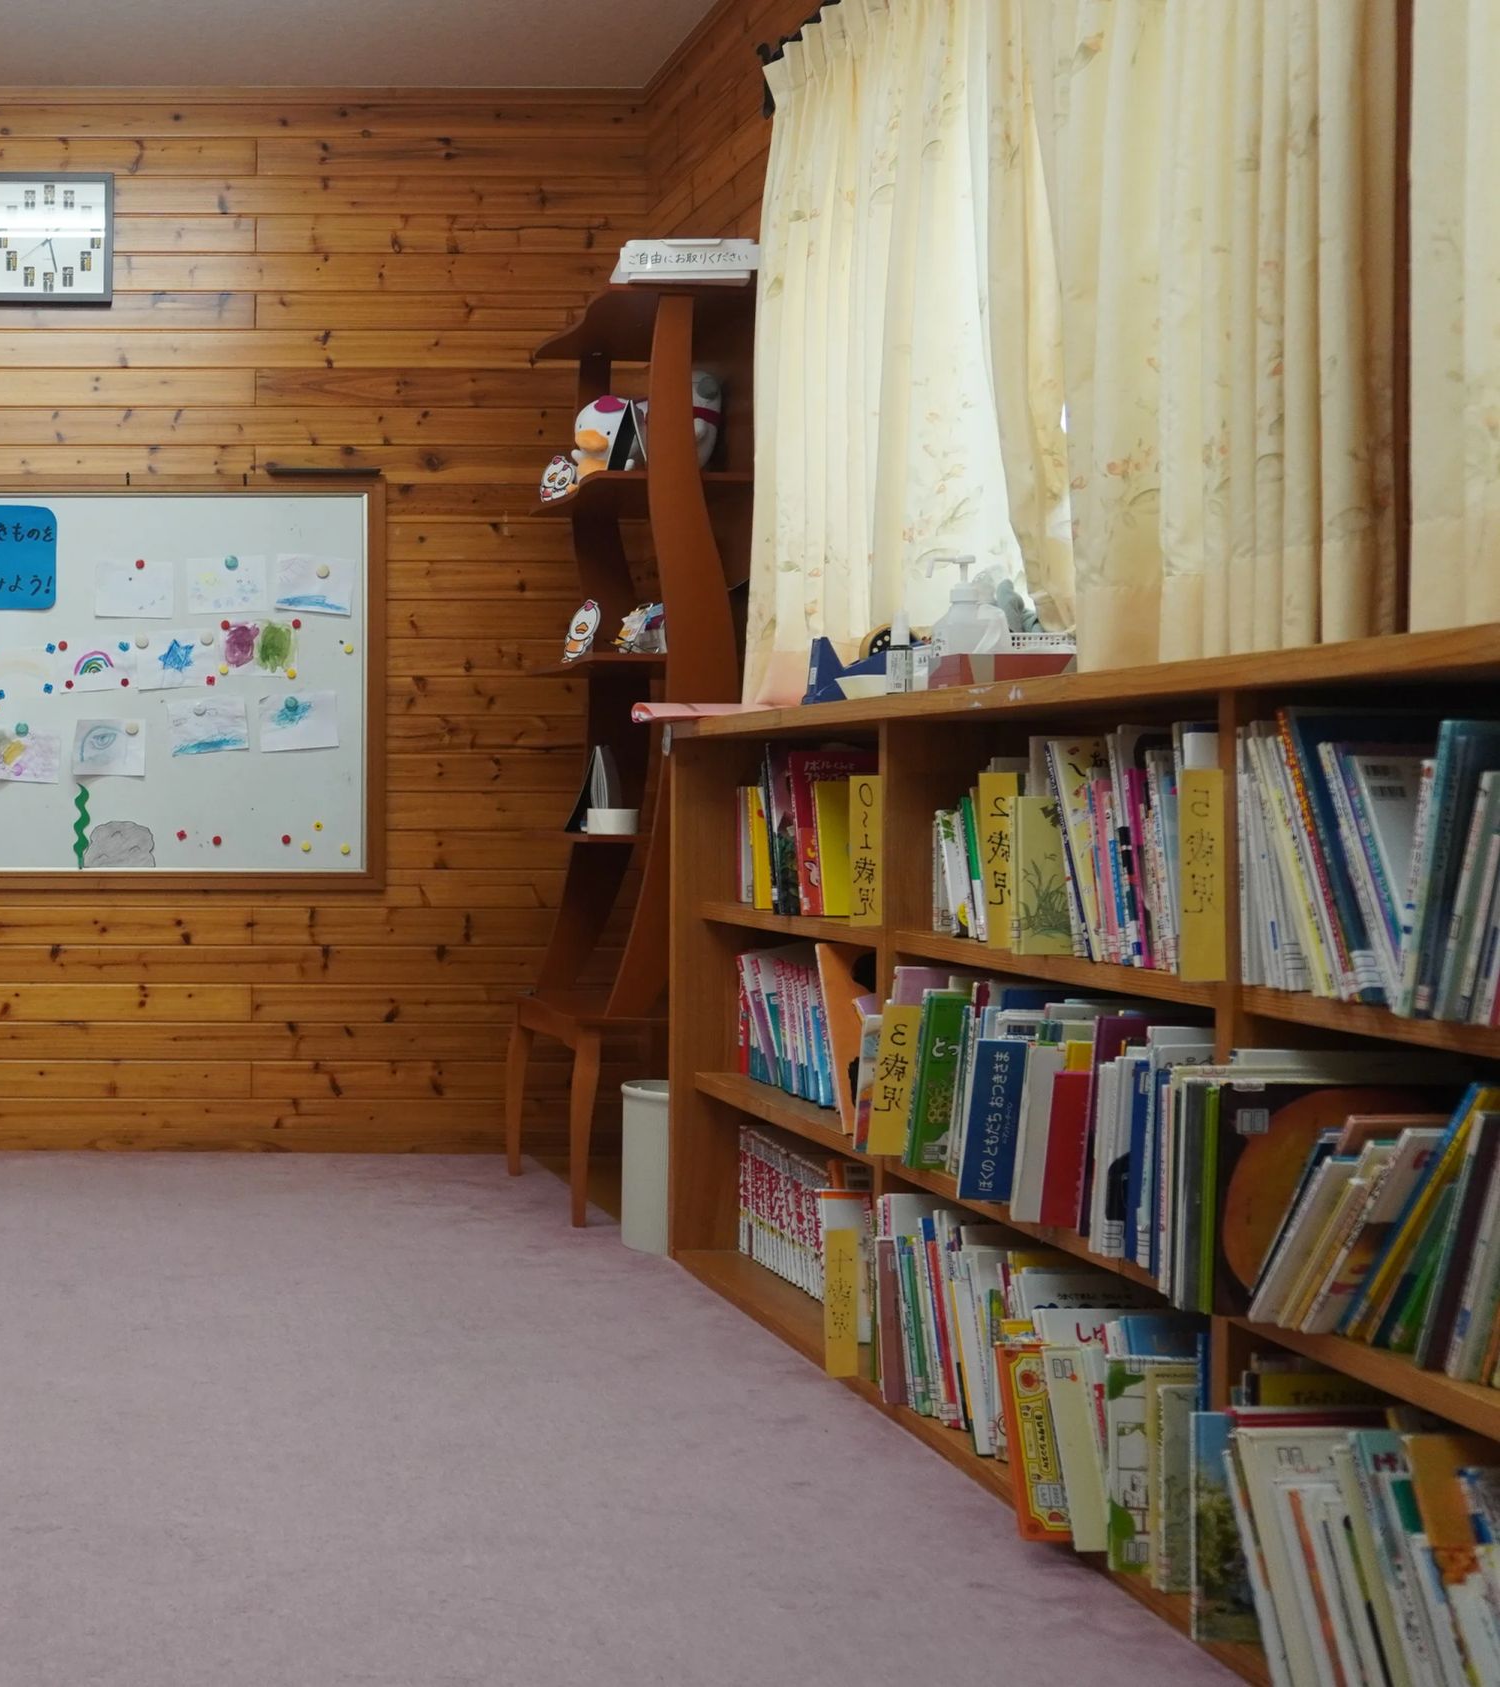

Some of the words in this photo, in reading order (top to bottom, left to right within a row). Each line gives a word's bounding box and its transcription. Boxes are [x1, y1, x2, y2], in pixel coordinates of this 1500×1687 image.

[628, 251, 749, 266] ご自由にお取りください
[989, 1050, 1011, 1107] おつきさま
[982, 1112, 1003, 1157] ともだち
[978, 1161, 997, 1192] ぼくの
